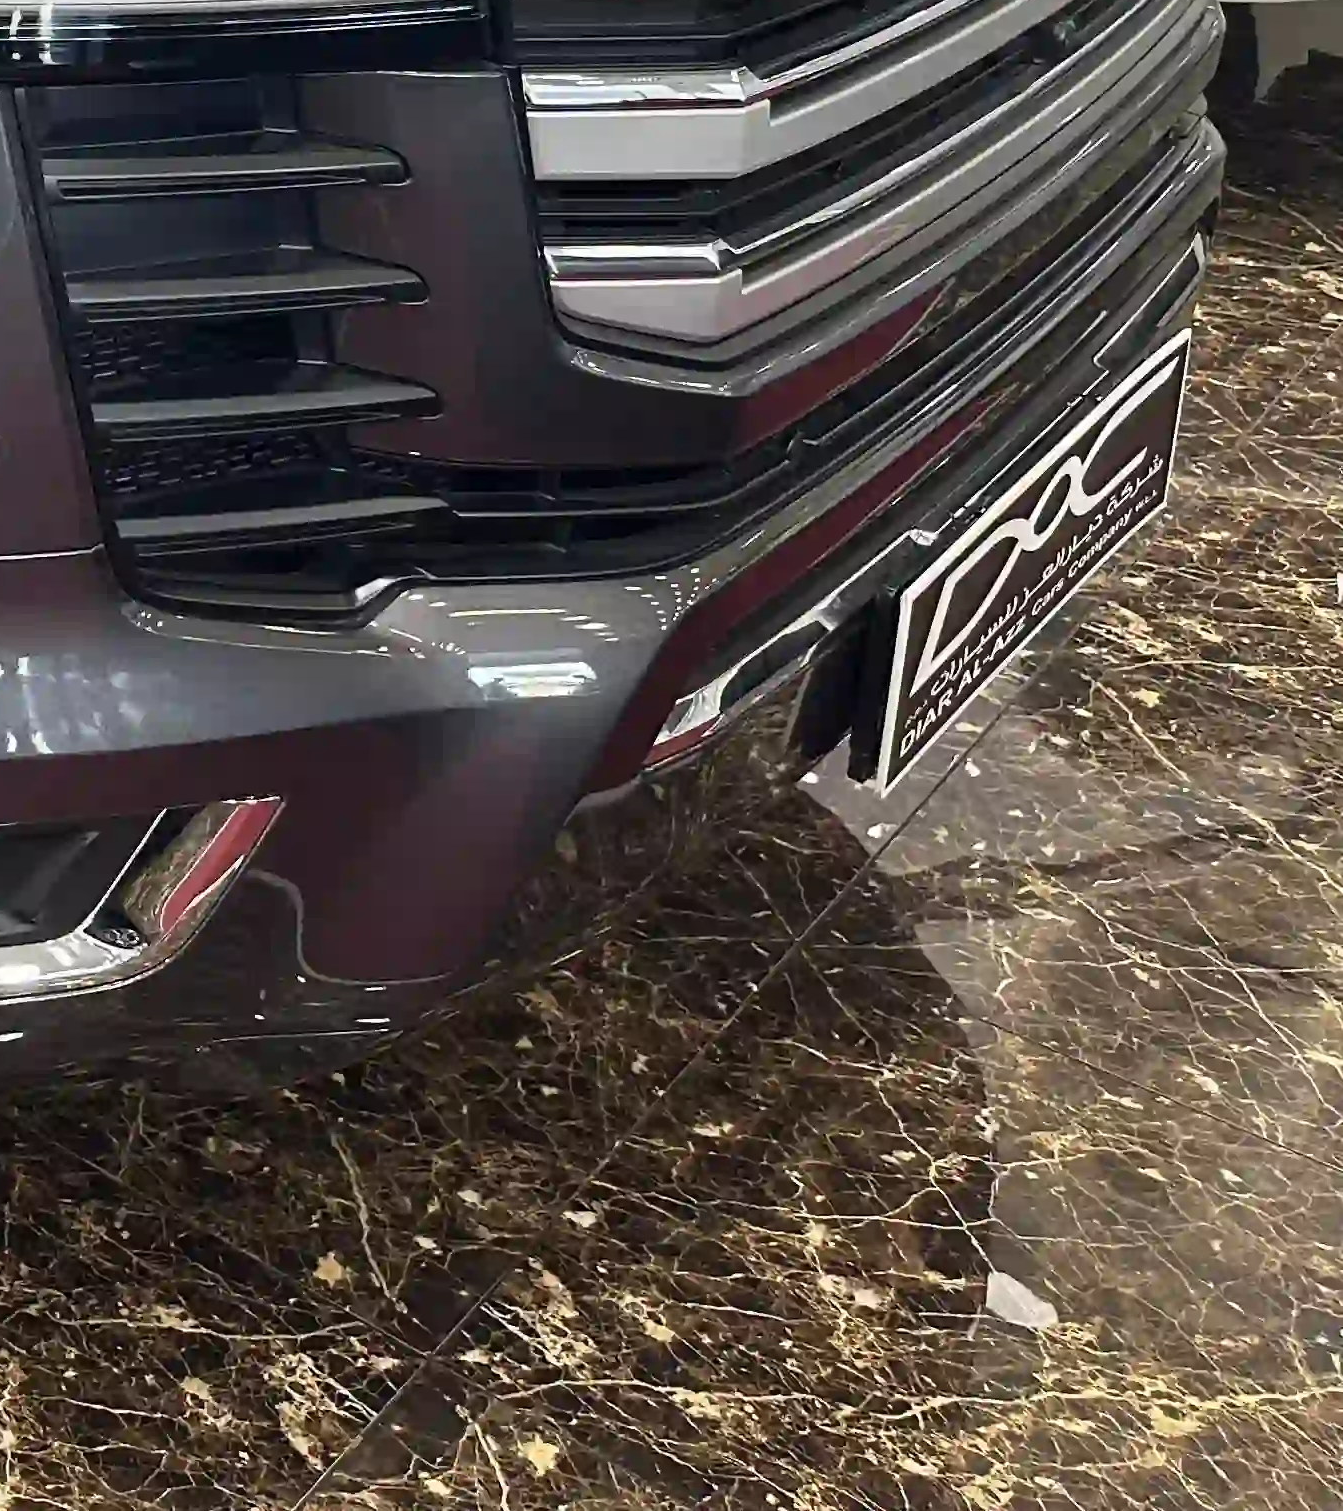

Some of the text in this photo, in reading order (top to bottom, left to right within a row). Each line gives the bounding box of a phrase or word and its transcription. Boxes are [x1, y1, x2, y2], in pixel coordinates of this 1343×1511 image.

[899, 687, 954, 758] DIAR
[955, 614, 1028, 697] AL-AZZ
[1031, 577, 1066, 616] Cars
[1067, 506, 1134, 579] Company
